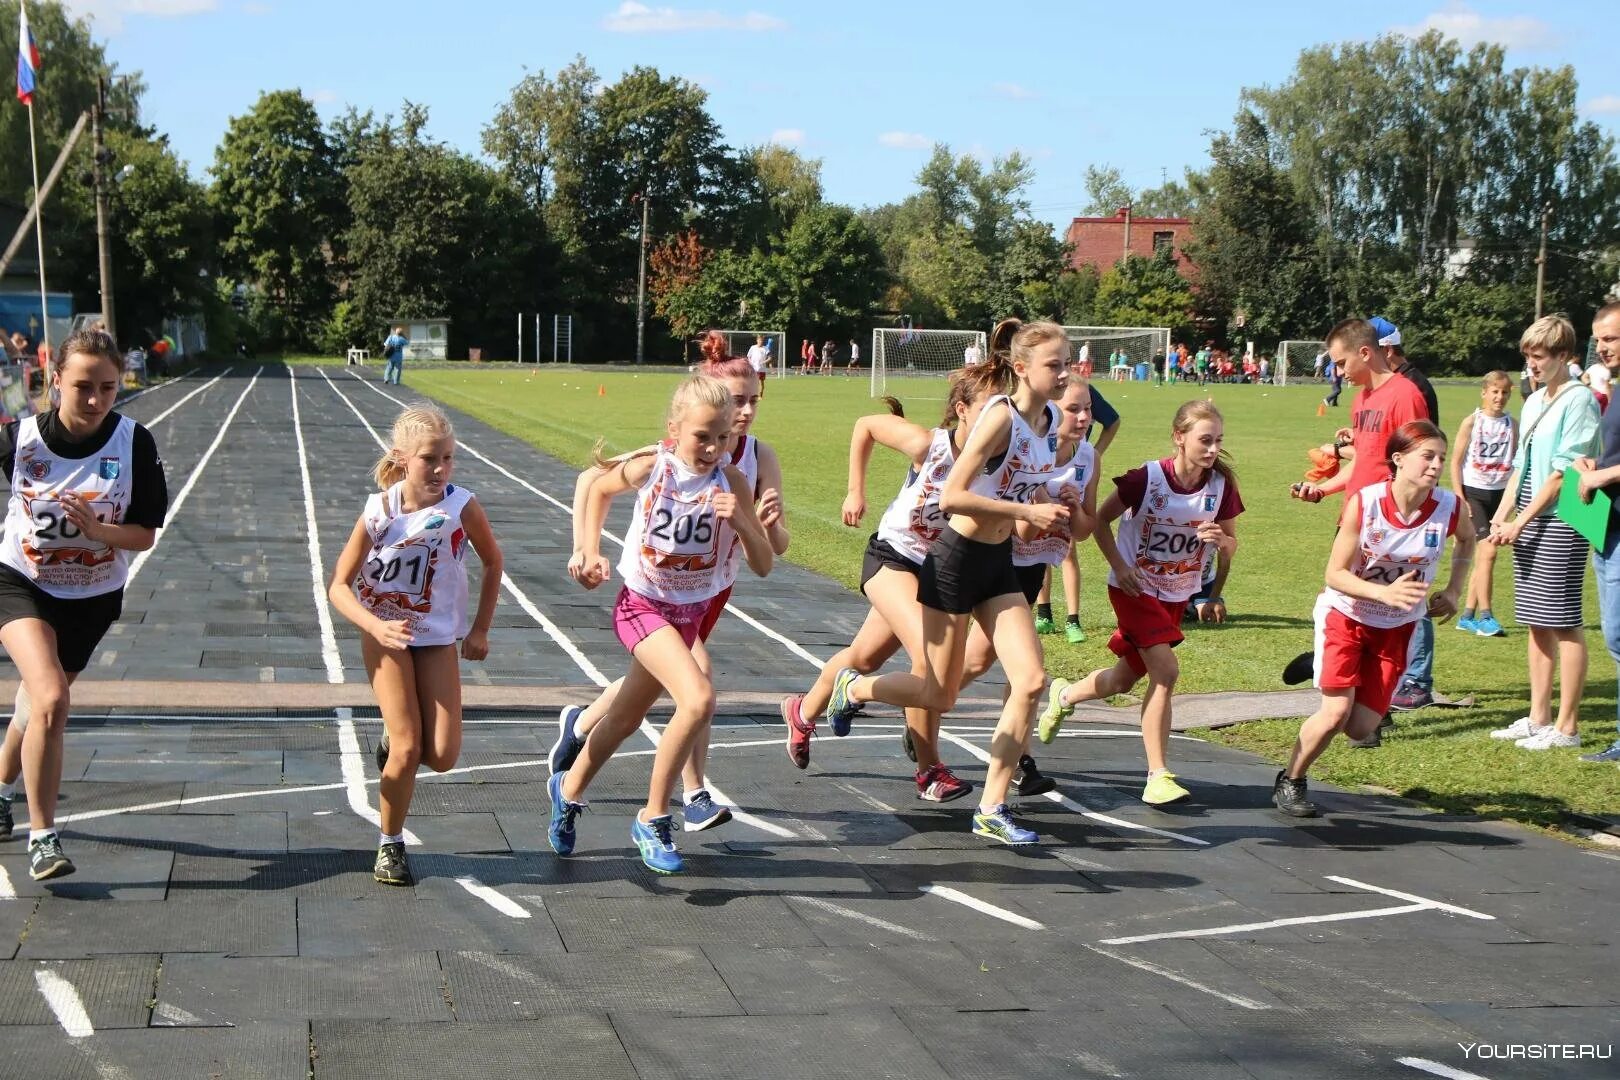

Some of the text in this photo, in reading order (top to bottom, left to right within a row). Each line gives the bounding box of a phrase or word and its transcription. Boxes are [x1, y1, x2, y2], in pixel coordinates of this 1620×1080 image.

[1479, 441, 1509, 458] 227
[650, 508, 713, 545] 205
[1149, 531, 1200, 554] 206
[366, 555, 422, 586] 201
